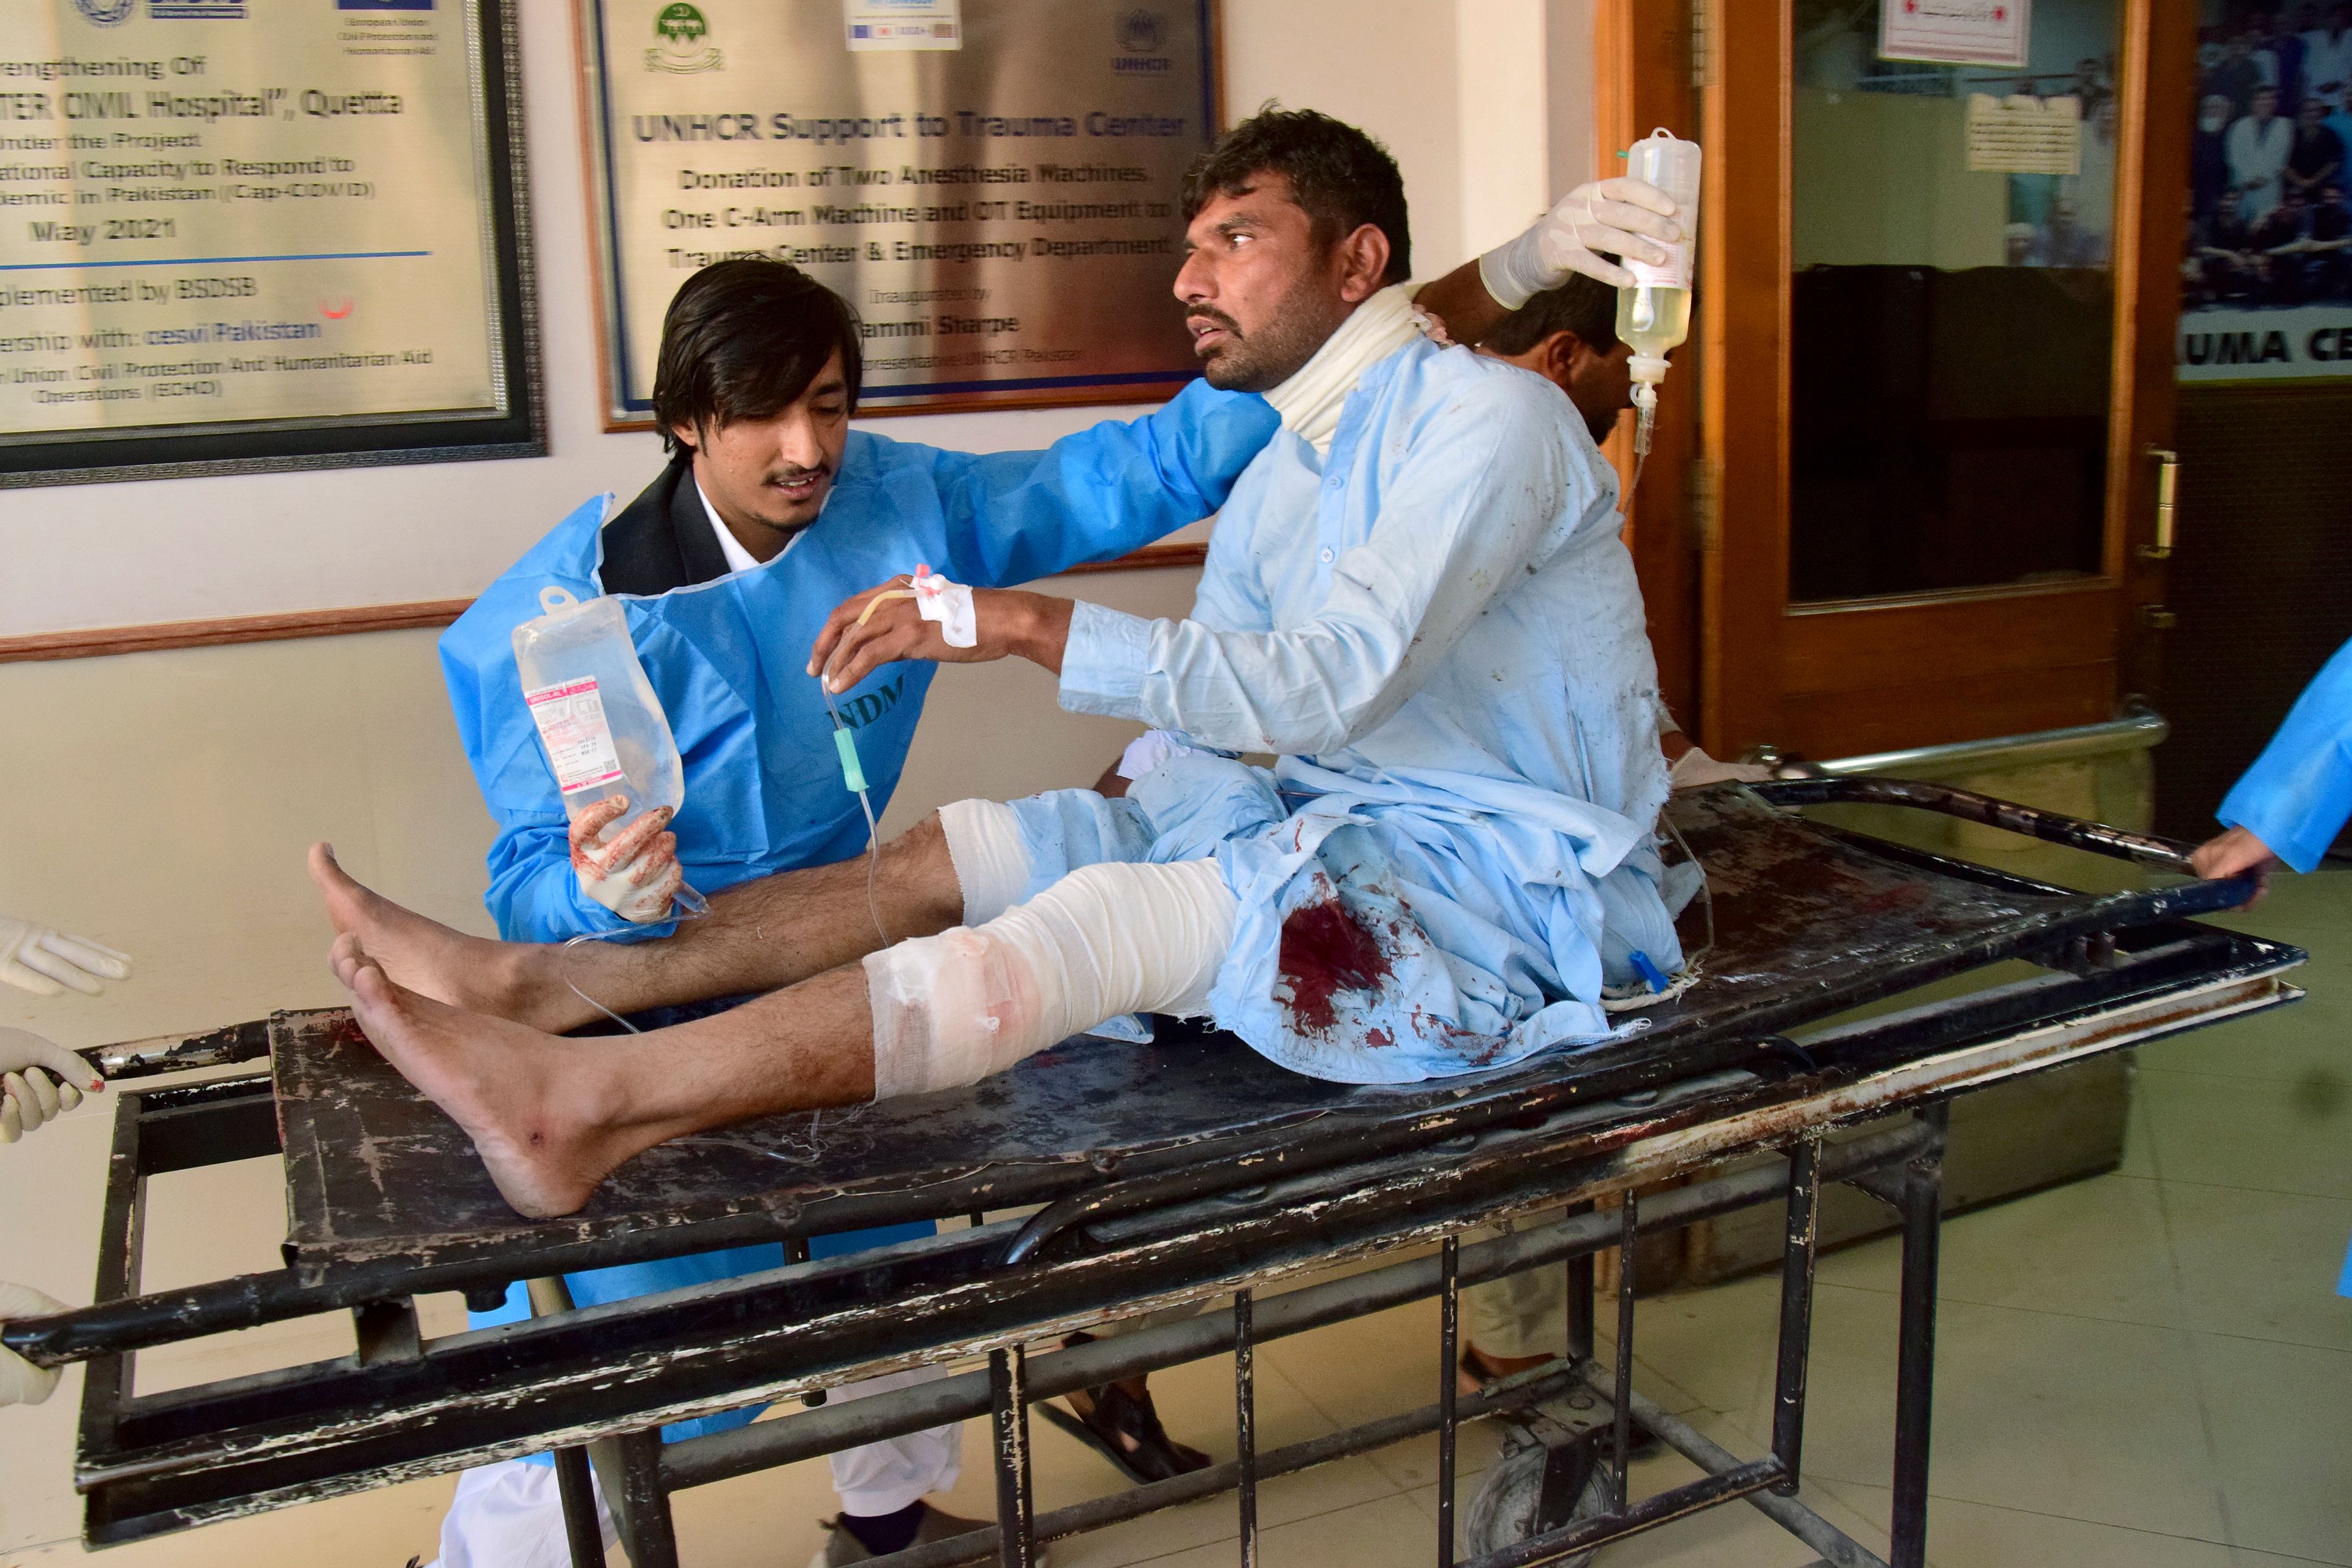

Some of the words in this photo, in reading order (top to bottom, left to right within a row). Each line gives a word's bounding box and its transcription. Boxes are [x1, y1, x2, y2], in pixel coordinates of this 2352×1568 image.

[170, 56, 206, 75] Of
[61, 92, 140, 118] CIVIL
[300, 89, 402, 119] Quetta
[633, 114, 766, 141] UNHCR
[768, 113, 905, 146] Support
[914, 113, 951, 137] to
[953, 111, 1077, 137] Trauma
[1084, 111, 1185, 137] Center
[68, 134, 107, 149] the
[111, 133, 202, 151] Project
[80, 160, 187, 182] Capacity
[189, 160, 216, 176] to
[221, 156, 326, 179] Respond
[328, 157, 355, 172] to
[677, 167, 800, 189] Donation
[805, 167, 829, 187] of
[826, 166, 893, 185] Two
[895, 164, 1032, 184] Anesthesia
[74, 189, 100, 204] in
[105, 186, 216, 202] Pakistan
[661, 208, 717, 229] One
[722, 206, 806, 227] C-Arm
[810, 204, 919, 225] Machine
[922, 204, 966, 222] and
[1012, 200, 1143, 225] Equipment
[28, 221, 96, 244] May
[104, 218, 176, 239] 2021
[774, 244, 858, 264] Center
[863, 241, 884, 262] &
[892, 240, 1028, 262] Emergency
[1030, 237, 1174, 258] Department
[135, 279, 171, 305] by
[173, 277, 258, 299] BSDSB
[145, 324, 209, 346] cesvi
[211, 320, 322, 342] Pakistan
[938, 315, 1020, 337] Sharpe
[2184, 330, 2293, 366] UMA
[12, 367, 70, 384] Union
[74, 364, 117, 381] Civil
[119, 359, 223, 378] Protection
[228, 356, 266, 373] And
[272, 352, 395, 371] Humanitarian
[400, 349, 432, 365] Aid
[32, 387, 141, 405] Operations
[145, 380, 223, 402] (ECHO)
